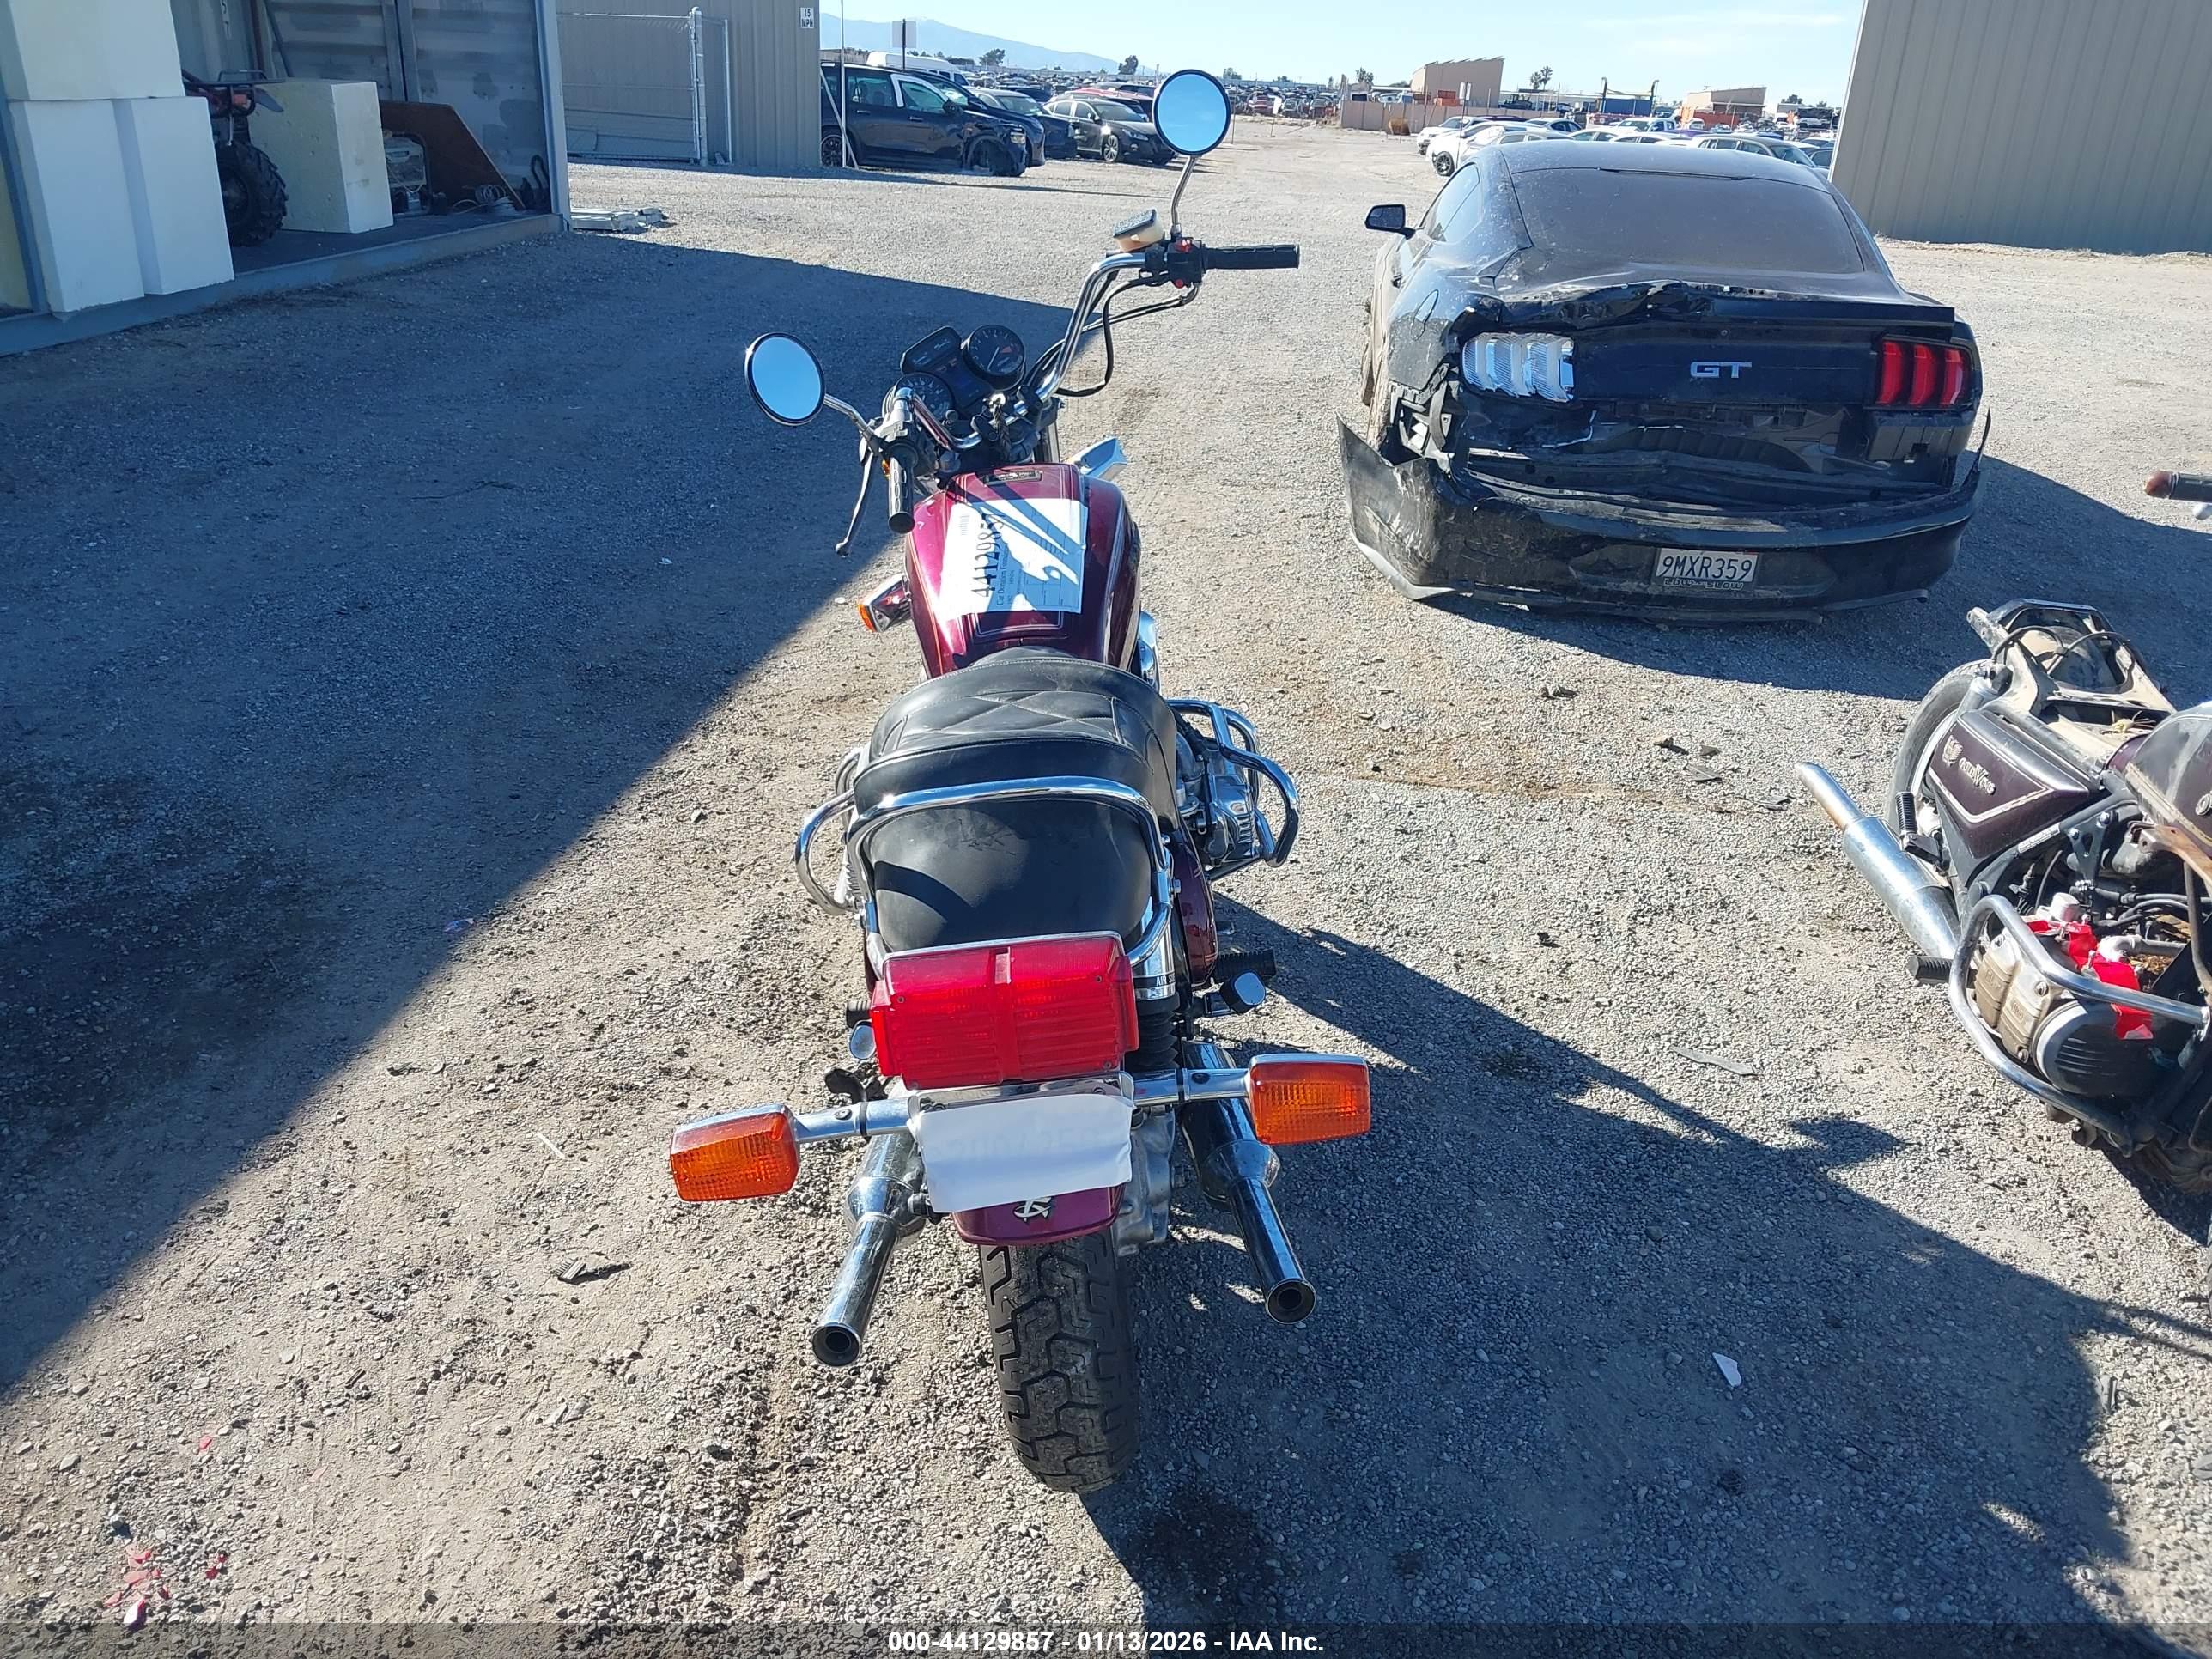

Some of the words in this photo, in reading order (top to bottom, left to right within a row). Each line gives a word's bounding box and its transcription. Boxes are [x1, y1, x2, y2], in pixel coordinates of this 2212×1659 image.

[804, 9, 811, 18] 15
[801, 18, 813, 27] MPH
[1690, 362, 1752, 378] GT
[970, 513, 1006, 597] 44129857
[1659, 556, 1753, 581] 9MXR359
[1156, 975, 1167, 987] AIR
